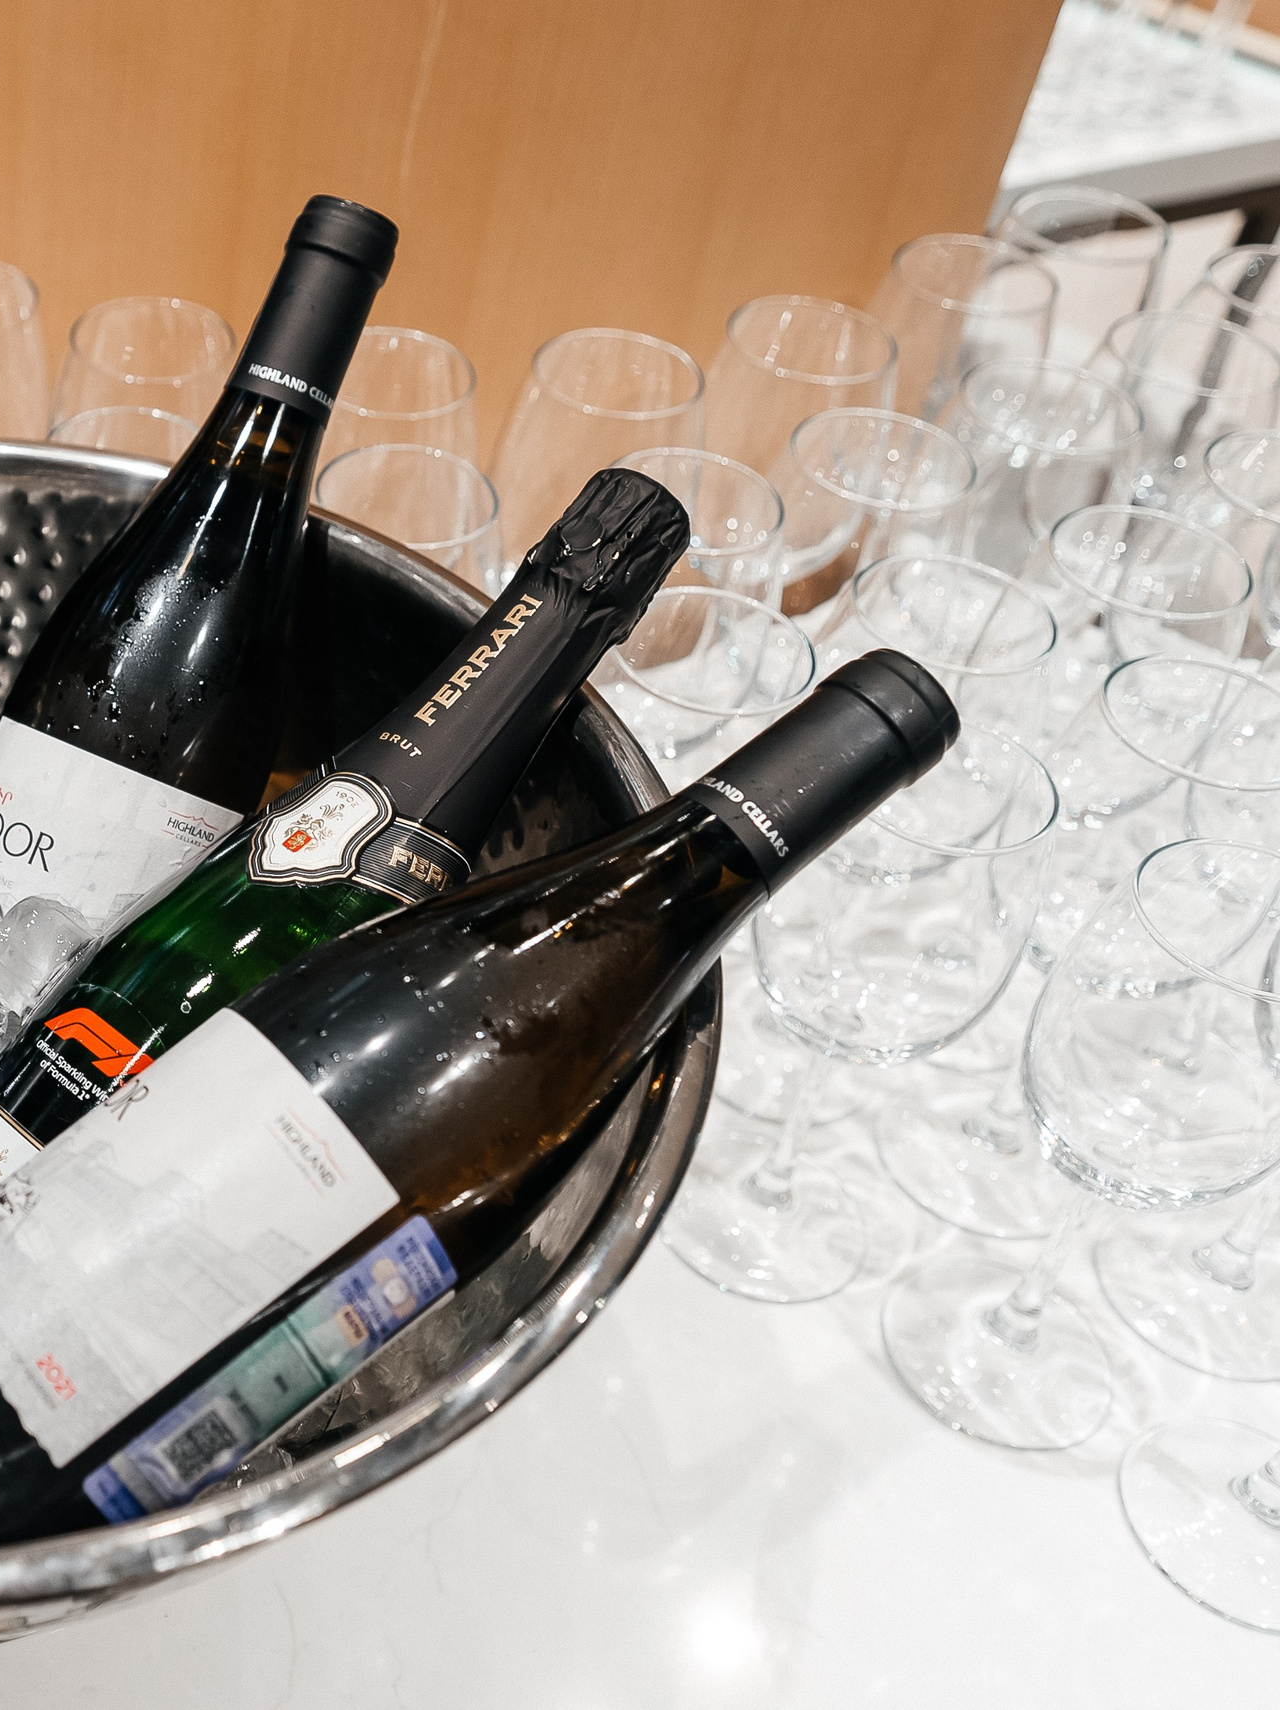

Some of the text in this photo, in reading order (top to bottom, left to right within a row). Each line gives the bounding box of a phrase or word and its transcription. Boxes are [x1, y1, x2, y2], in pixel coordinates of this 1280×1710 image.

[248, 363, 308, 393] HIGHLAND
[413, 592, 544, 727] FERRARI
[379, 731, 422, 759] BRUT
[166, 816, 215, 843] HIGHLAND
[741, 800, 790, 858] CELLARS
[36, 1039, 58, 1061] Official
[55, 1056, 93, 1090] Sparkling
[40, 1059, 51, 1070] of
[47, 1065, 80, 1096] Formula
[34, 1350, 77, 1401] 2021
